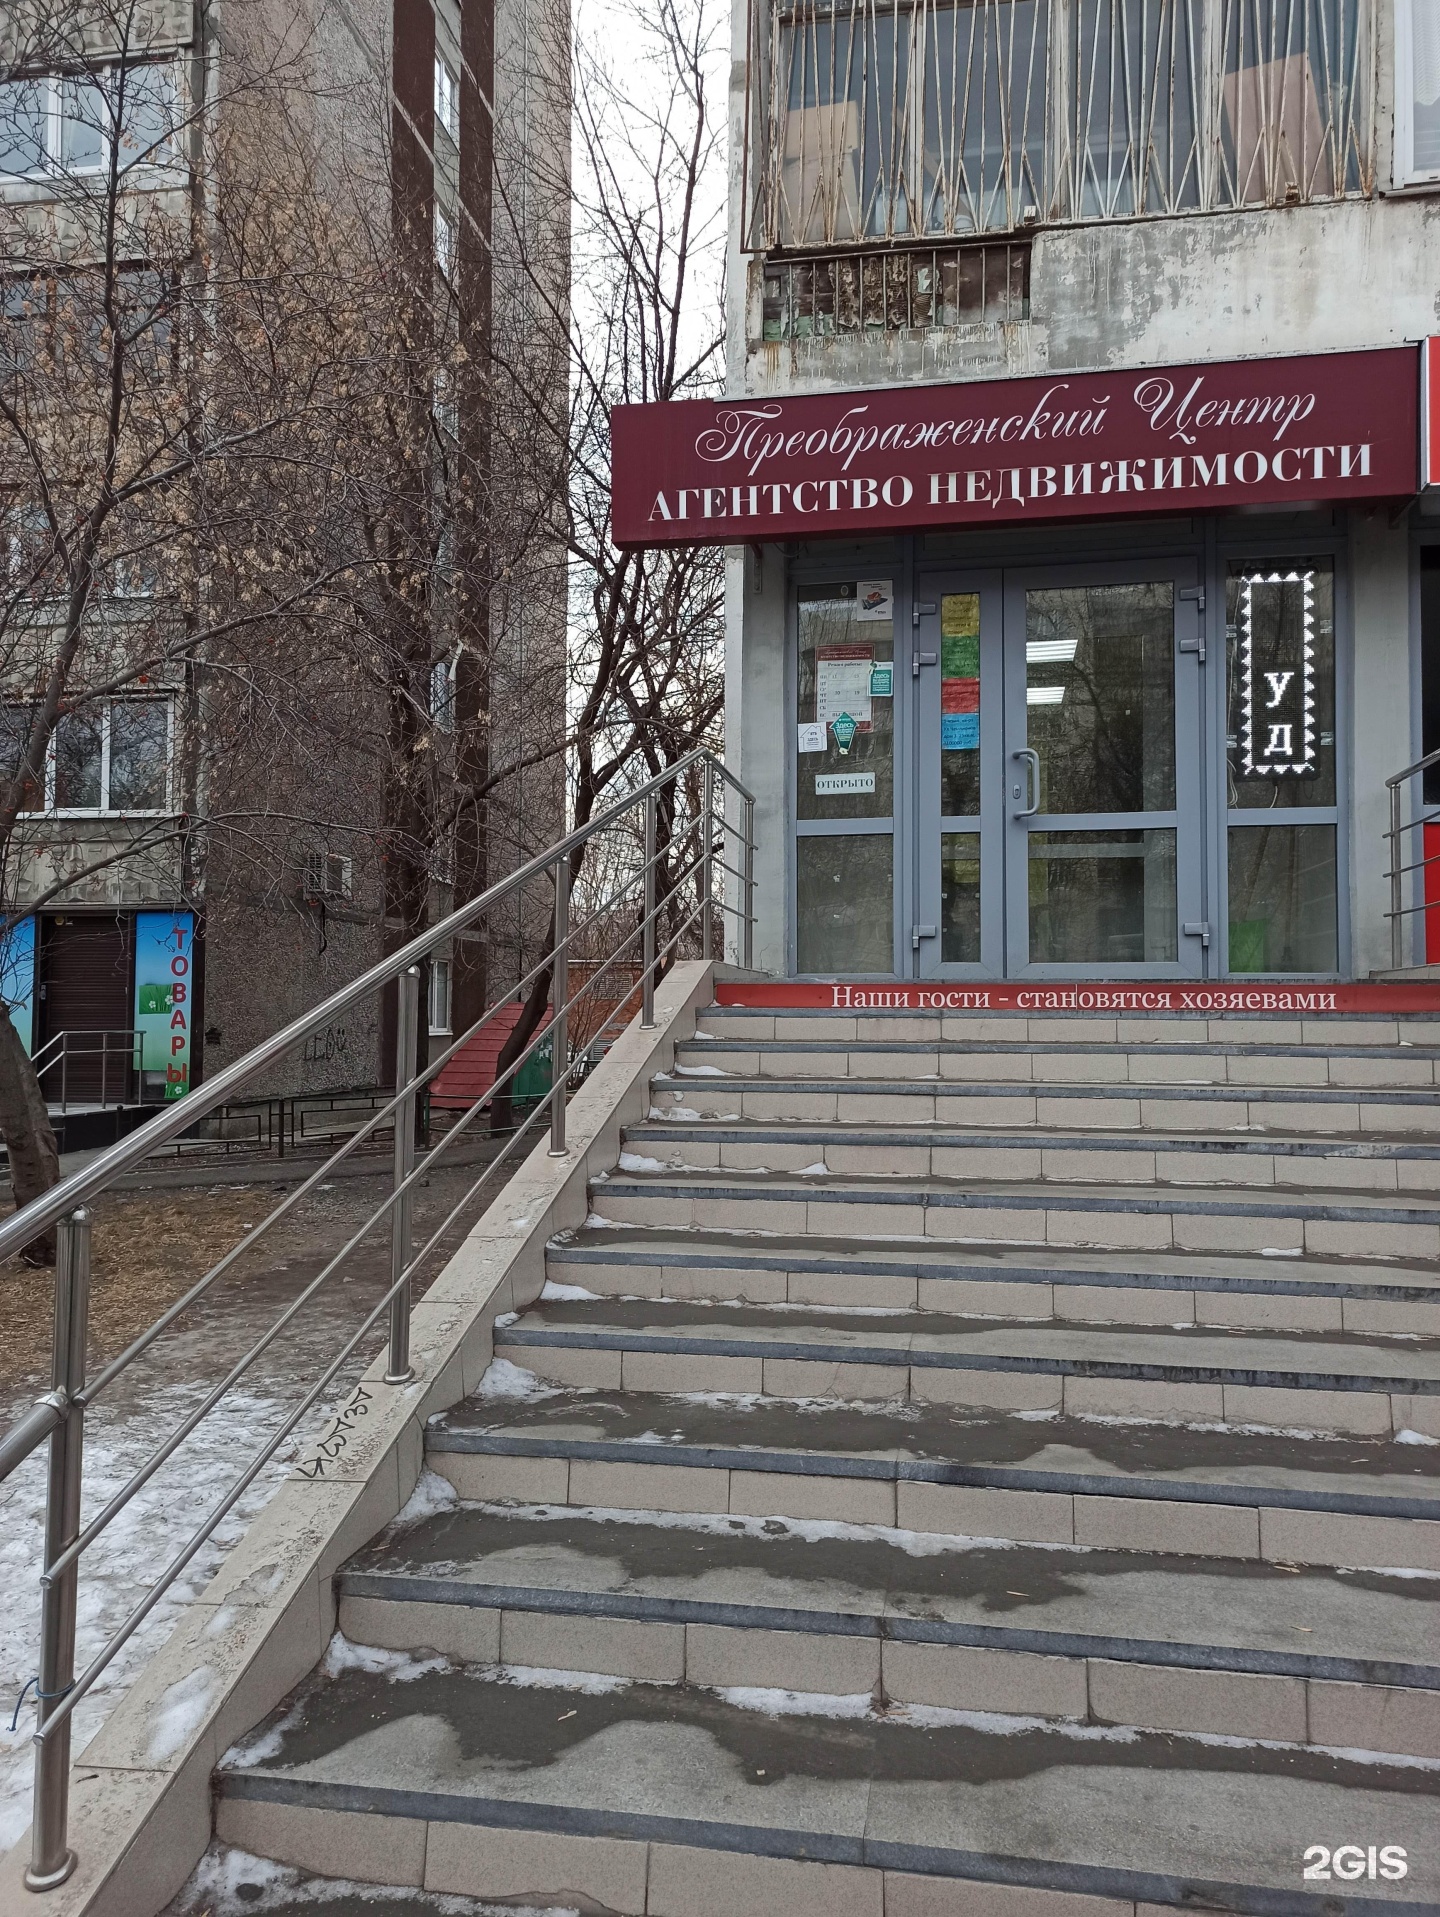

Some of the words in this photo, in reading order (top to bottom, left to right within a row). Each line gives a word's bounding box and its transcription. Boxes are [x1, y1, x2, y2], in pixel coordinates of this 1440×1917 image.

[695, 384, 1110, 476] Преображенский
[1133, 376, 1315, 444] Центр
[648, 475, 913, 521] АГЕНТСТВО
[926, 444, 1374, 508] НЕДВИЖИМОСТИ
[817, 778, 873, 789] ОТКРЫТО
[167, 929, 189, 1083] ТОВАРЫ
[832, 986, 909, 1008] Наши
[918, 991, 990, 1008] гости
[1016, 991, 1172, 1009] становятся
[1180, 991, 1337, 1010] хозяевами
